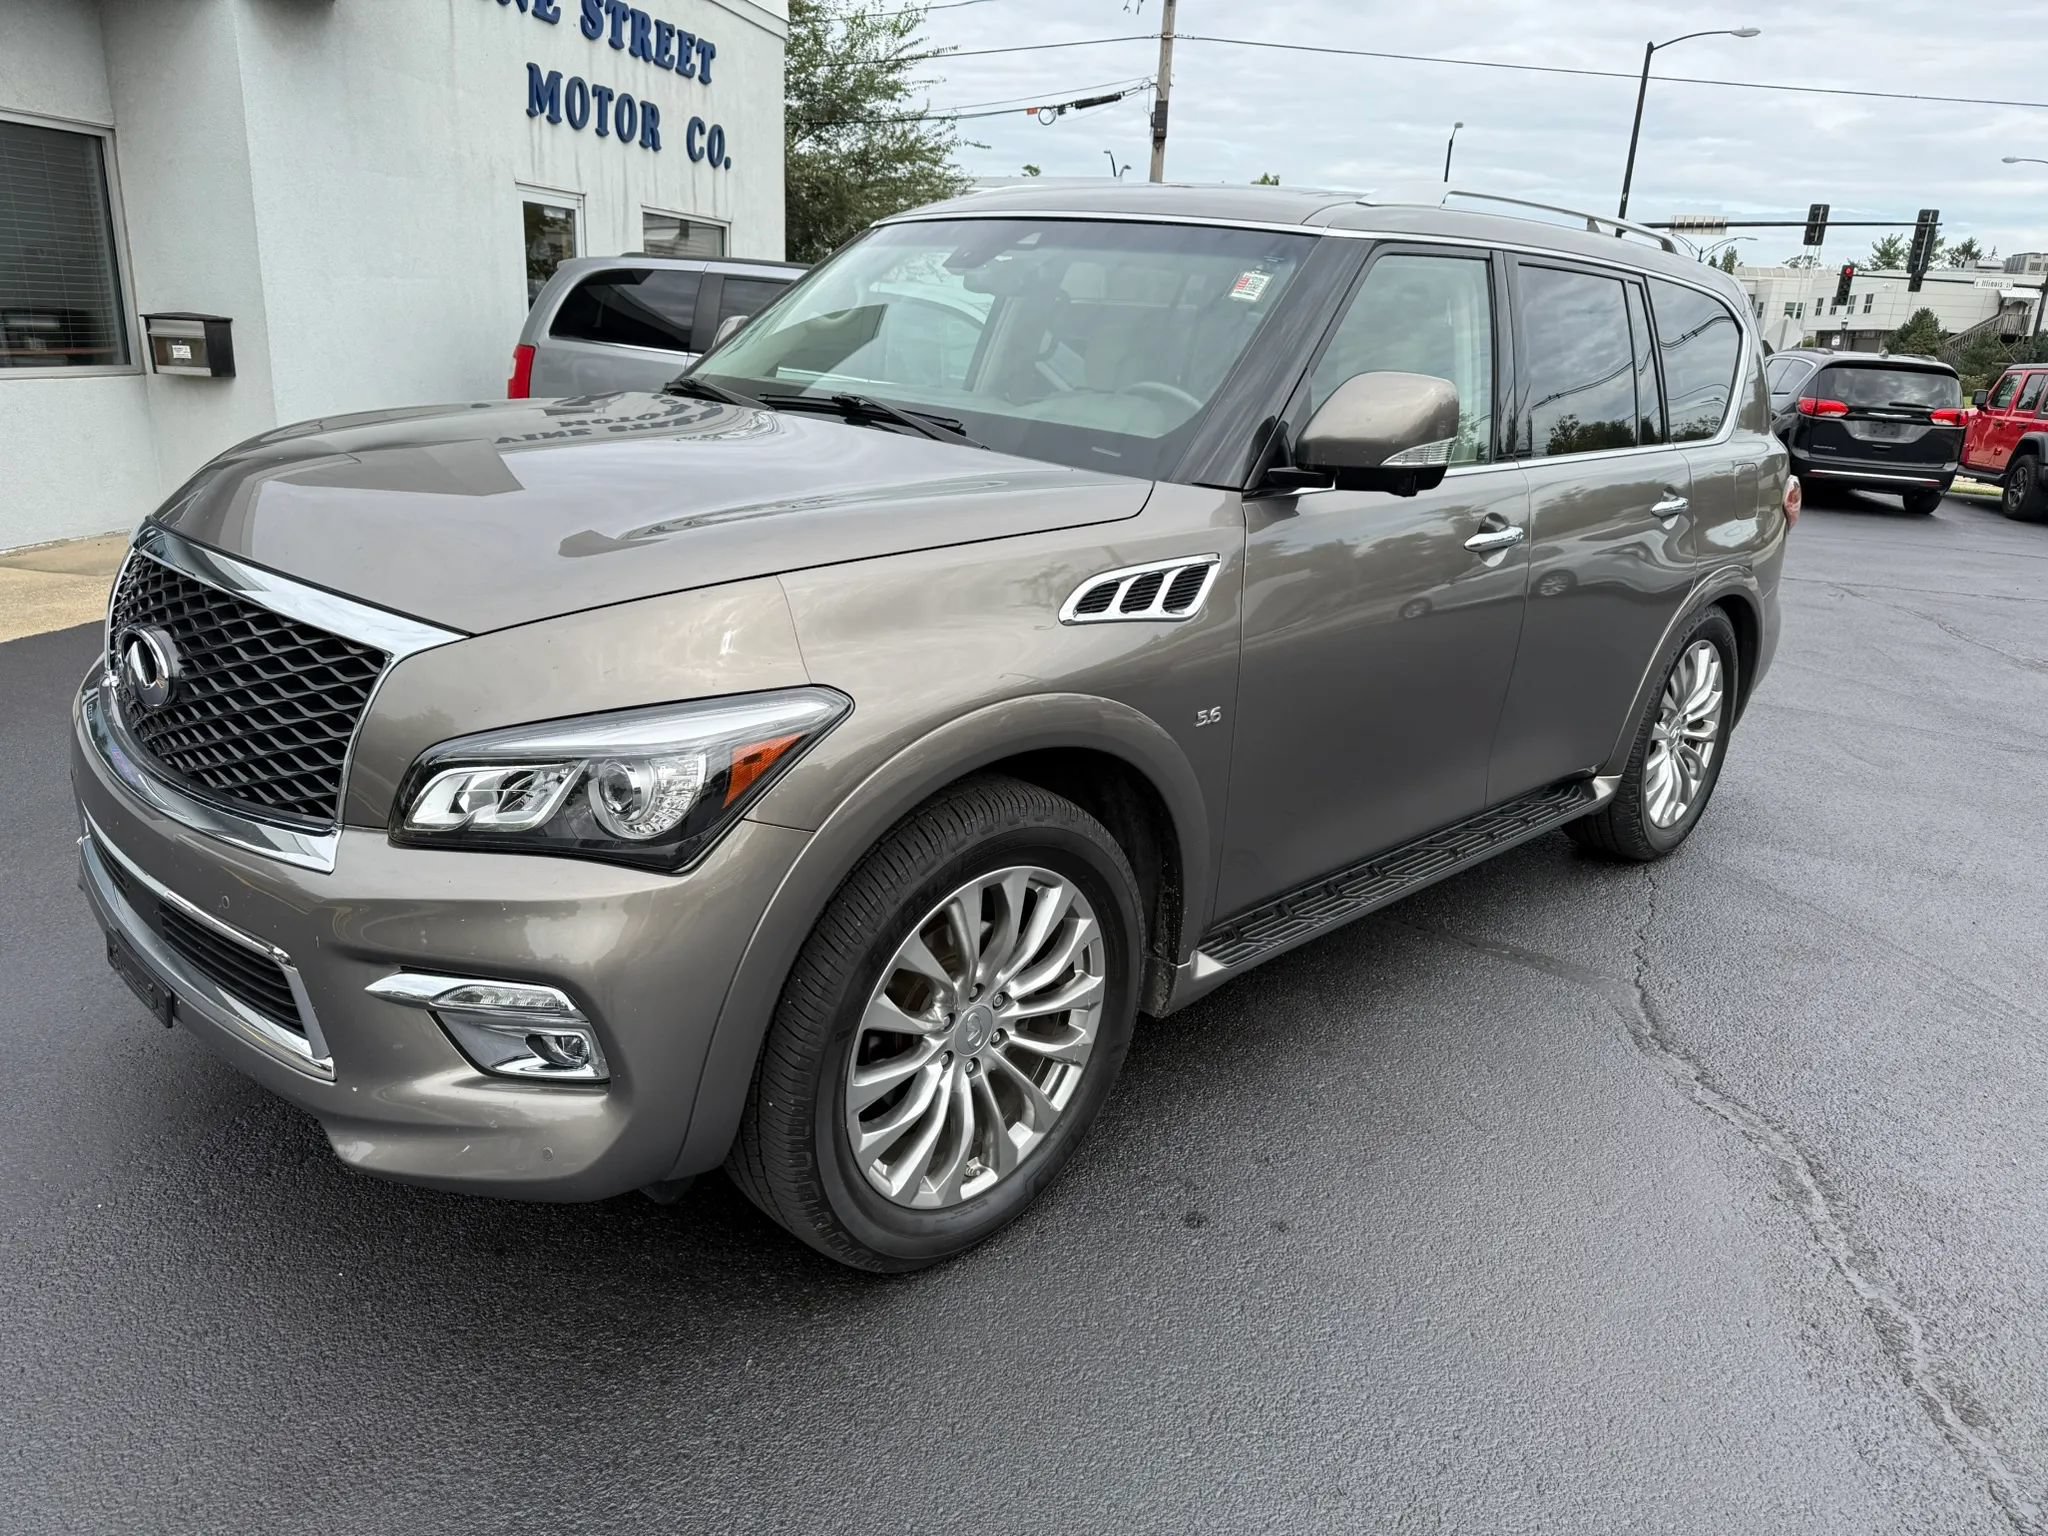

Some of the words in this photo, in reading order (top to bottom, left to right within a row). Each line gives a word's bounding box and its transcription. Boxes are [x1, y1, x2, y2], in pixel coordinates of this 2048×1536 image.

[580, 0, 716, 85] STREET
[526, 62, 662, 152] MOTOR
[686, 115, 732, 170] CO.
[1195, 706, 1222, 728] 5.6
